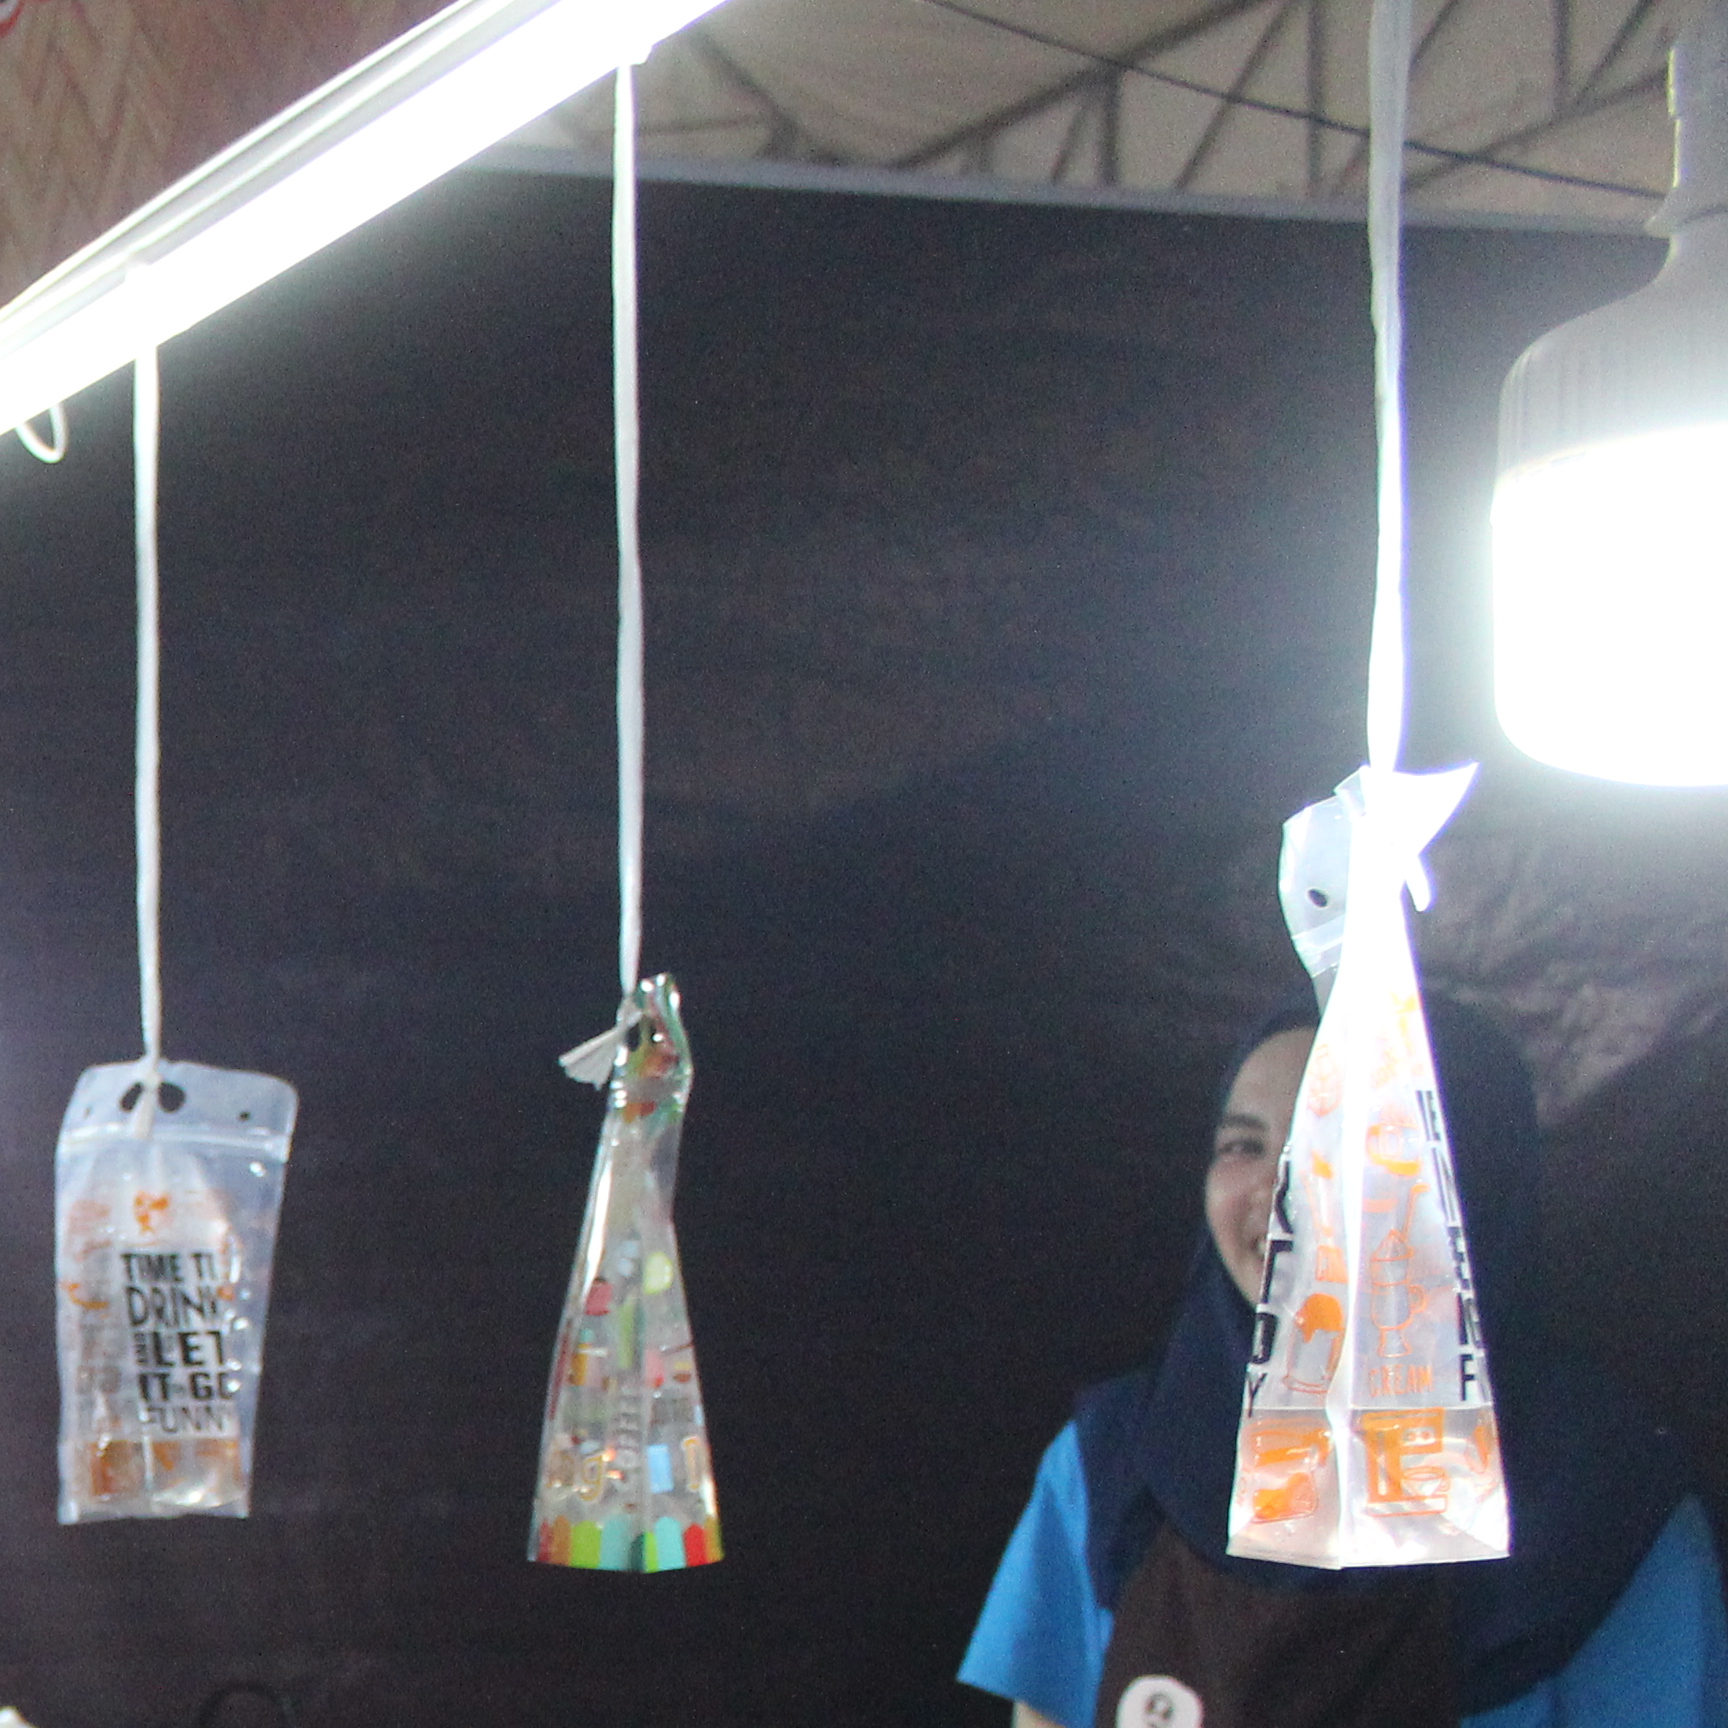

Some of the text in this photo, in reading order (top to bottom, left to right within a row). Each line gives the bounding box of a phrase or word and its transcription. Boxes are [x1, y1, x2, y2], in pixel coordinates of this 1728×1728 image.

[121, 1252, 184, 1284] TIME
[1368, 1366, 1437, 1400] CREAM
[145, 1403, 228, 1434] FUNN
